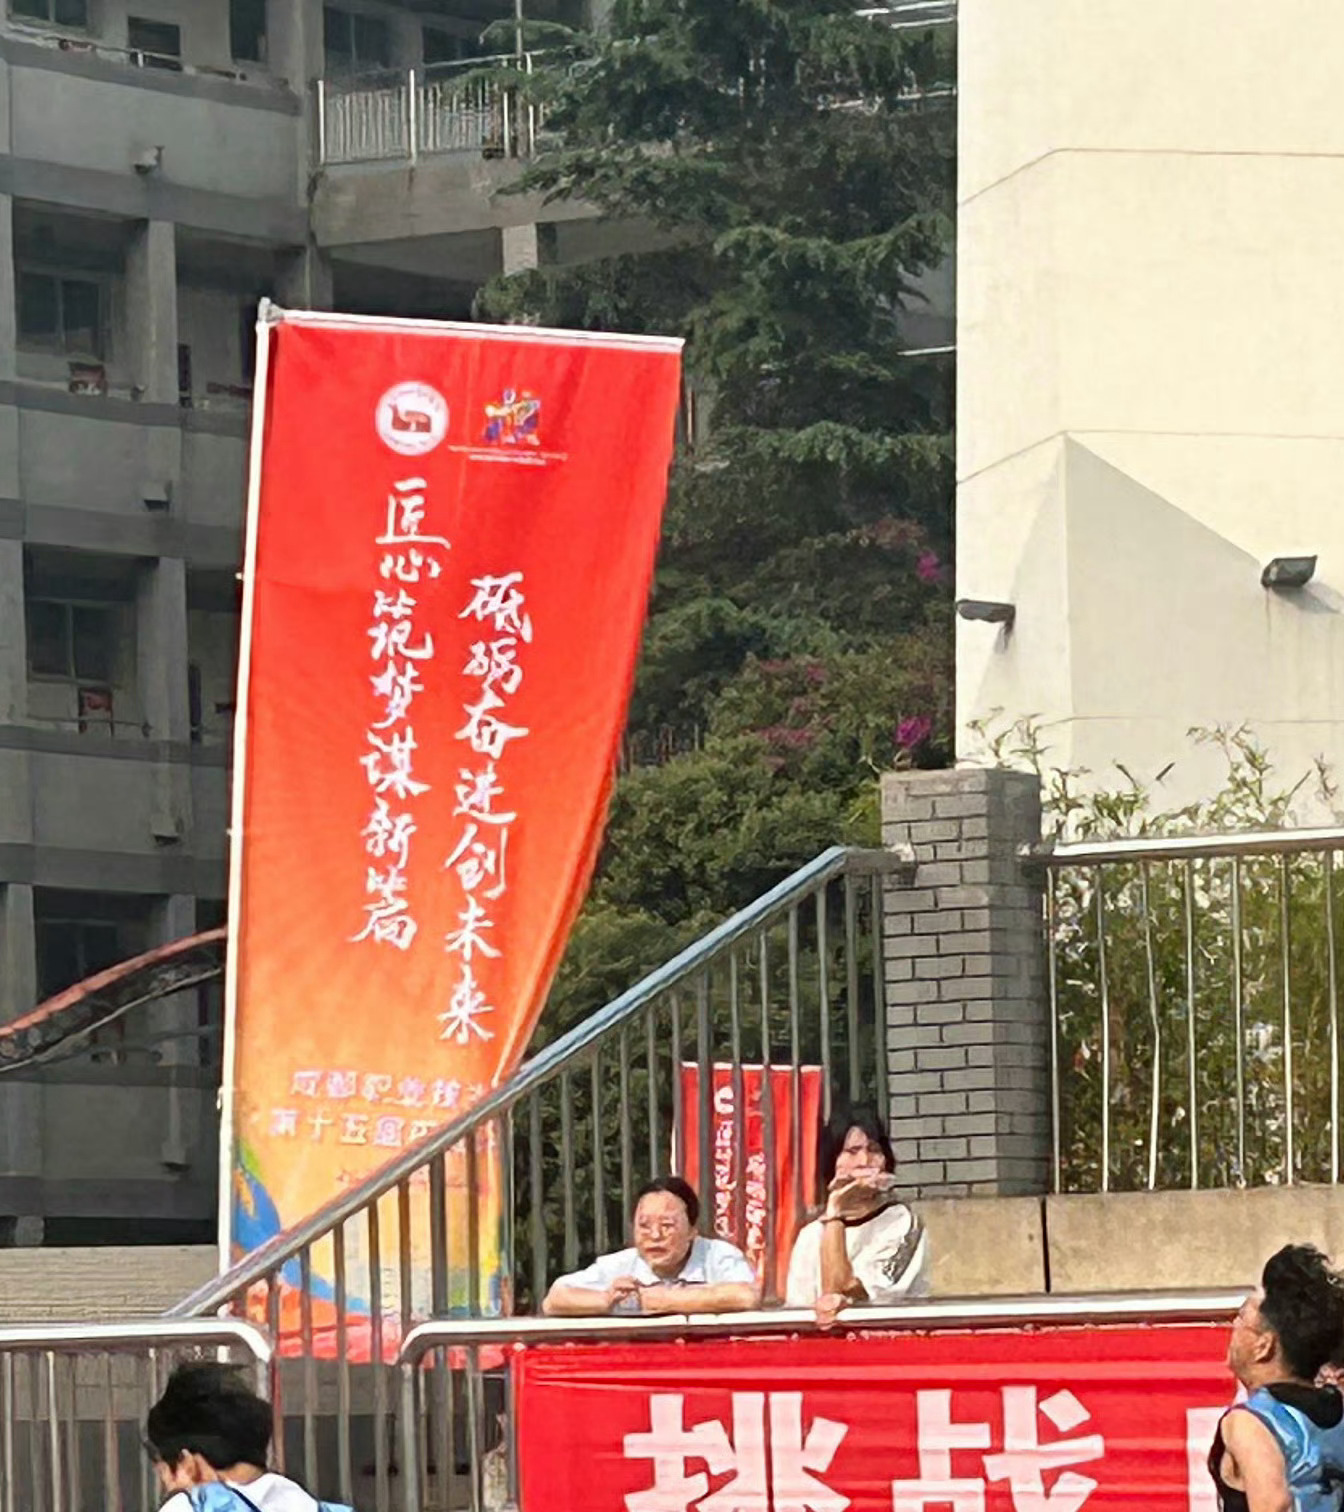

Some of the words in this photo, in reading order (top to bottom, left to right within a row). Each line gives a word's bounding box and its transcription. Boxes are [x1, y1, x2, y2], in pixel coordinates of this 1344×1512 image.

[346, 477, 452, 950] 匠心筑梦谋新篇
[436, 571, 533, 1045] 砥砺奋进创未来
